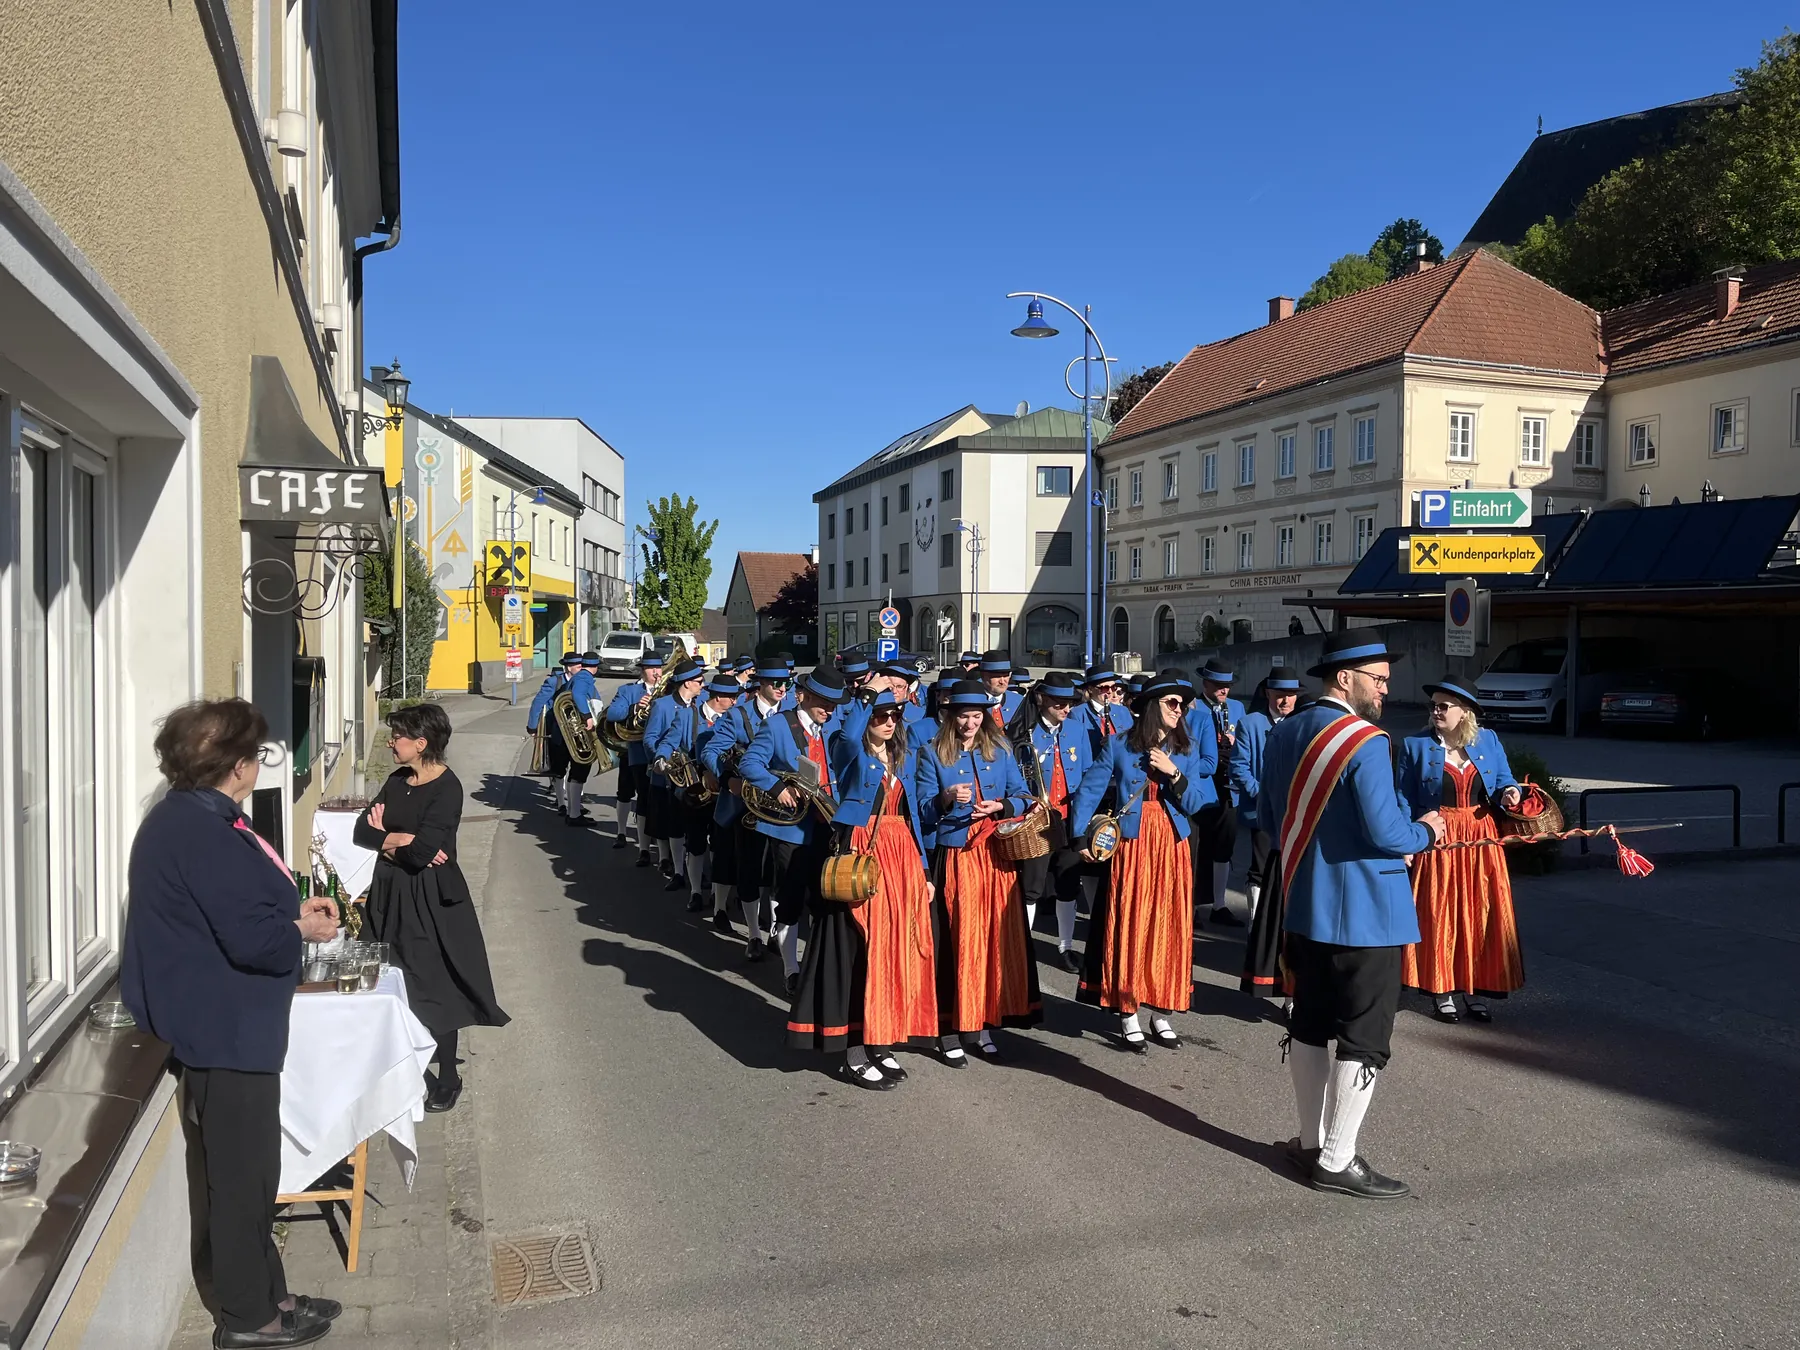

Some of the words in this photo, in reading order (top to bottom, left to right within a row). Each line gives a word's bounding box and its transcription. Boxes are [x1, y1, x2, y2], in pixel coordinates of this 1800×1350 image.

[1424, 494, 1446, 523] P
[1452, 500, 1512, 517] Einfahrt
[1443, 547, 1536, 563] Kundenparkplatz
[1143, 585, 1160, 593] TABAK
[1164, 583, 1183, 592] TRAFIK
[1229, 578, 1251, 588] CHINA
[1253, 574, 1302, 586] RESTAURANT
[881, 641, 895, 659] P
